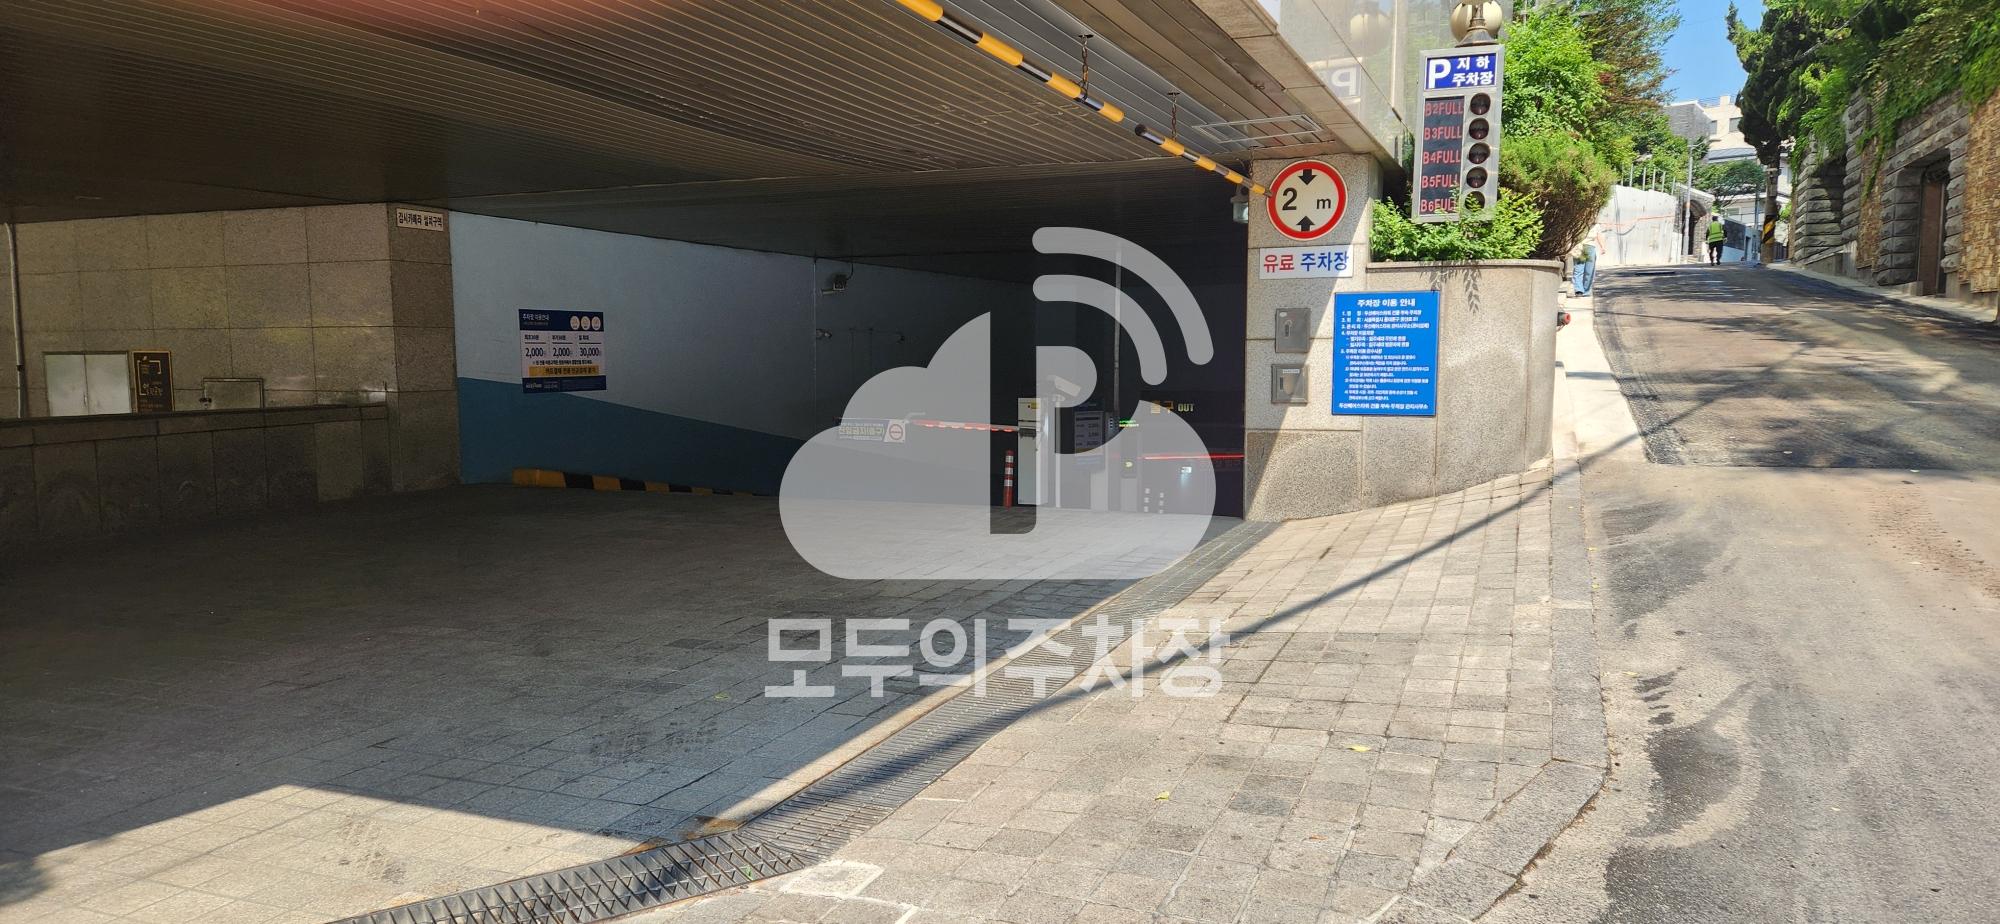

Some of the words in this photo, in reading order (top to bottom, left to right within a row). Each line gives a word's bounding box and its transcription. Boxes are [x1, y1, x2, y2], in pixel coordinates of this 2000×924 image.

[1428, 58, 1451, 88] P
[1452, 71, 1494, 87] 주차장
[1282, 187, 1298, 211] 2
[1316, 198, 1331, 209] m
[1264, 254, 1295, 273] 유료
[1301, 251, 1349, 272] 주차장
[1357, 299, 1380, 307] 주차장
[1400, 298, 1416, 307] 안내
[525, 347, 546, 358] 2,000
[553, 347, 573, 358] 2,000
[580, 347, 601, 358] 30,000
[1178, 403, 1194, 412] OUT
